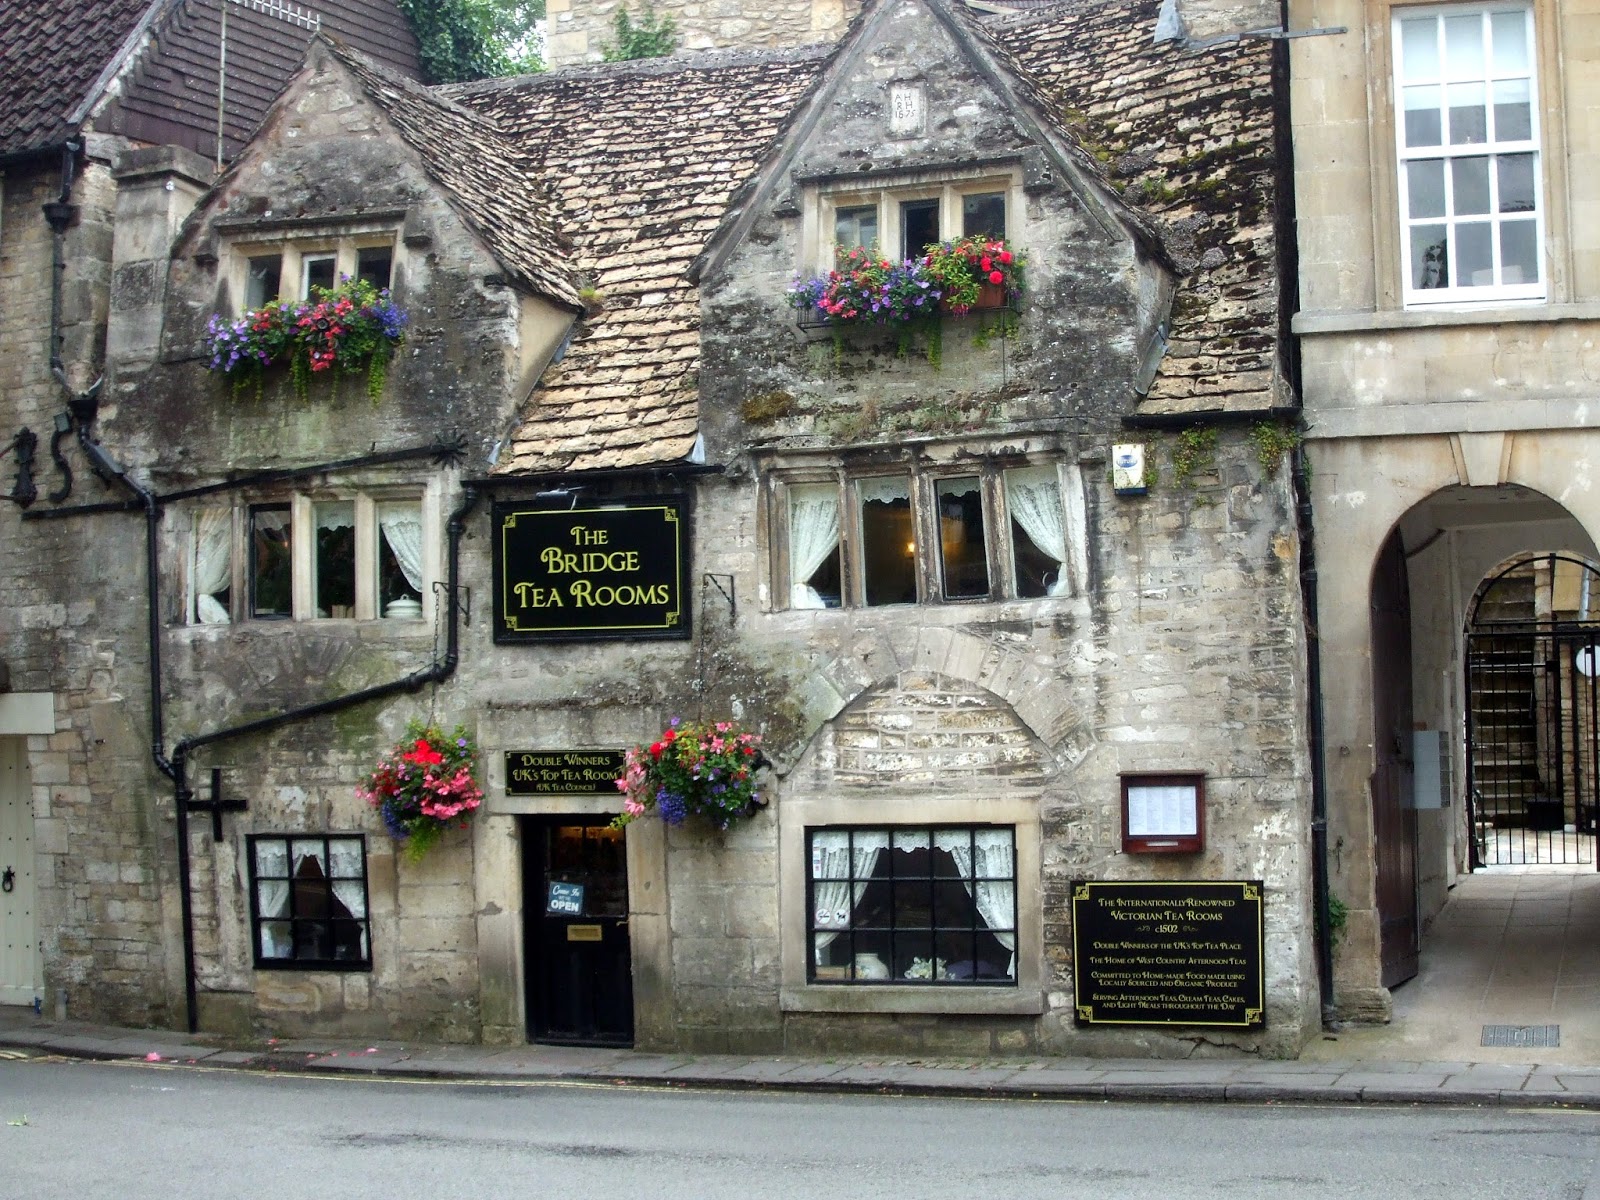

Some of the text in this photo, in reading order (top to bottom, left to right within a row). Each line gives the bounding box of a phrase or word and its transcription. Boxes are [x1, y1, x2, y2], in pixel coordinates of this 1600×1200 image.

[570, 526, 609, 546] THE
[540, 546, 641, 574] BRIDGE
[513, 580, 669, 608] TEA ROOMS
[521, 754, 610, 767] DOUBLE WINNERS
[541, 769, 560, 781] TOP
[561, 769, 581, 781] TEA
[551, 899, 579, 912] OPEN
[1098, 898, 1236, 907] THE INTERNATIONALLY RENOWNED
[1111, 910, 1223, 920] VICTORIAN TEA ROOMS
[1093, 941, 1119, 949] DOUBLE
[1120, 941, 1149, 949] WINNERS
[1191, 942, 1204, 950] TOP
[1205, 942, 1219, 950] TEA
[1220, 942, 1242, 950] PLACE
[1089, 956, 1103, 964] THE
[1104, 956, 1126, 964] HOME
[1136, 956, 1154, 964] WEST
[1155, 956, 1186, 964] COUNTRY
[1188, 957, 1228, 965] AFTERNOON
[1229, 957, 1246, 965] TEAS
[1091, 971, 1131, 979] COMMITTED
[1128, 979, 1158, 987] SOURCED
[1092, 993, 1118, 1001] SERVING
[1178, 994, 1203, 1002] CREAM
[1138, 1001, 1161, 1009] MEALS
[1220, 1002, 1236, 1010] DAY
